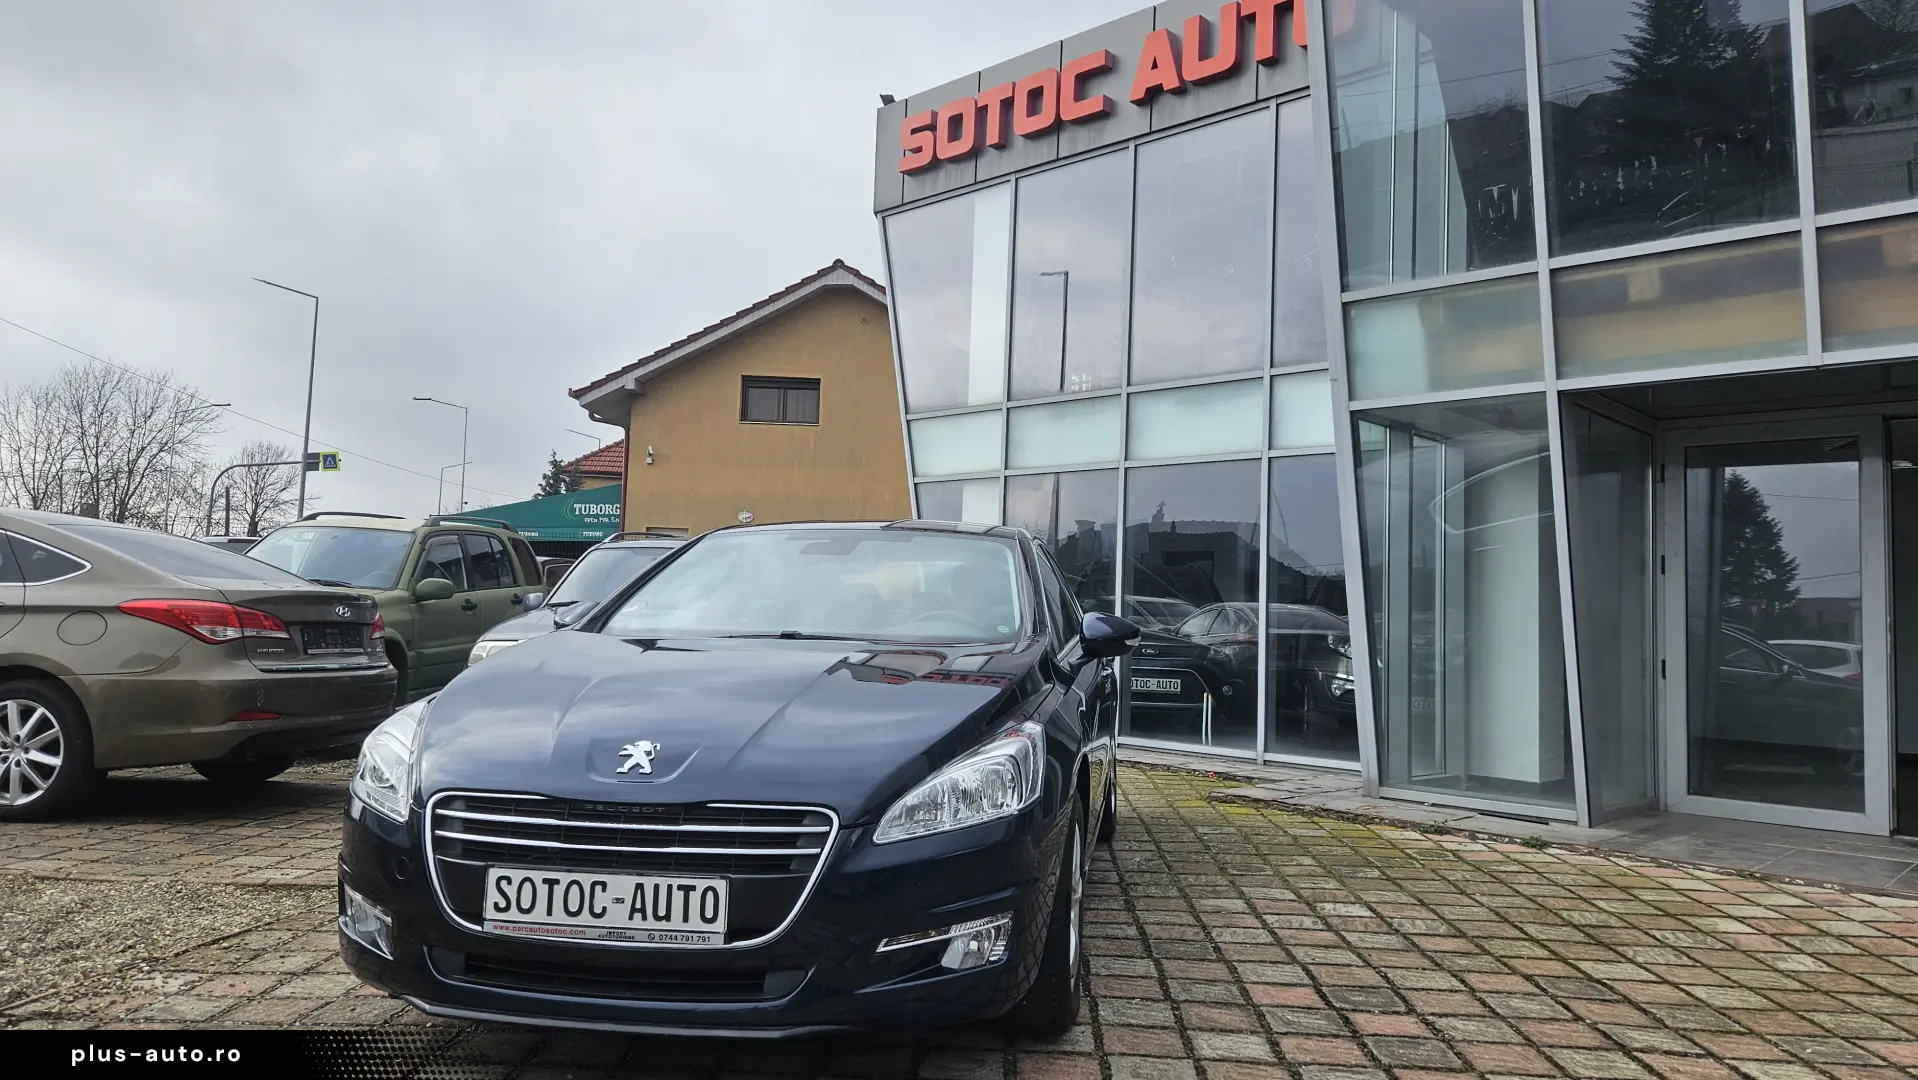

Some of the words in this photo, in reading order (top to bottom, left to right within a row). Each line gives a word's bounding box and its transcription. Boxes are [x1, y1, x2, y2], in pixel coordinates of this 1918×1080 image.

[898, 48, 1113, 175] SOTOC
[573, 503, 620, 515] TUBORG
[584, 804, 666, 812] PEUGEOT
[492, 923, 586, 936] www.parcautosotoc.com
[658, 934, 678, 942] 0744
[697, 935, 711, 943] 791
